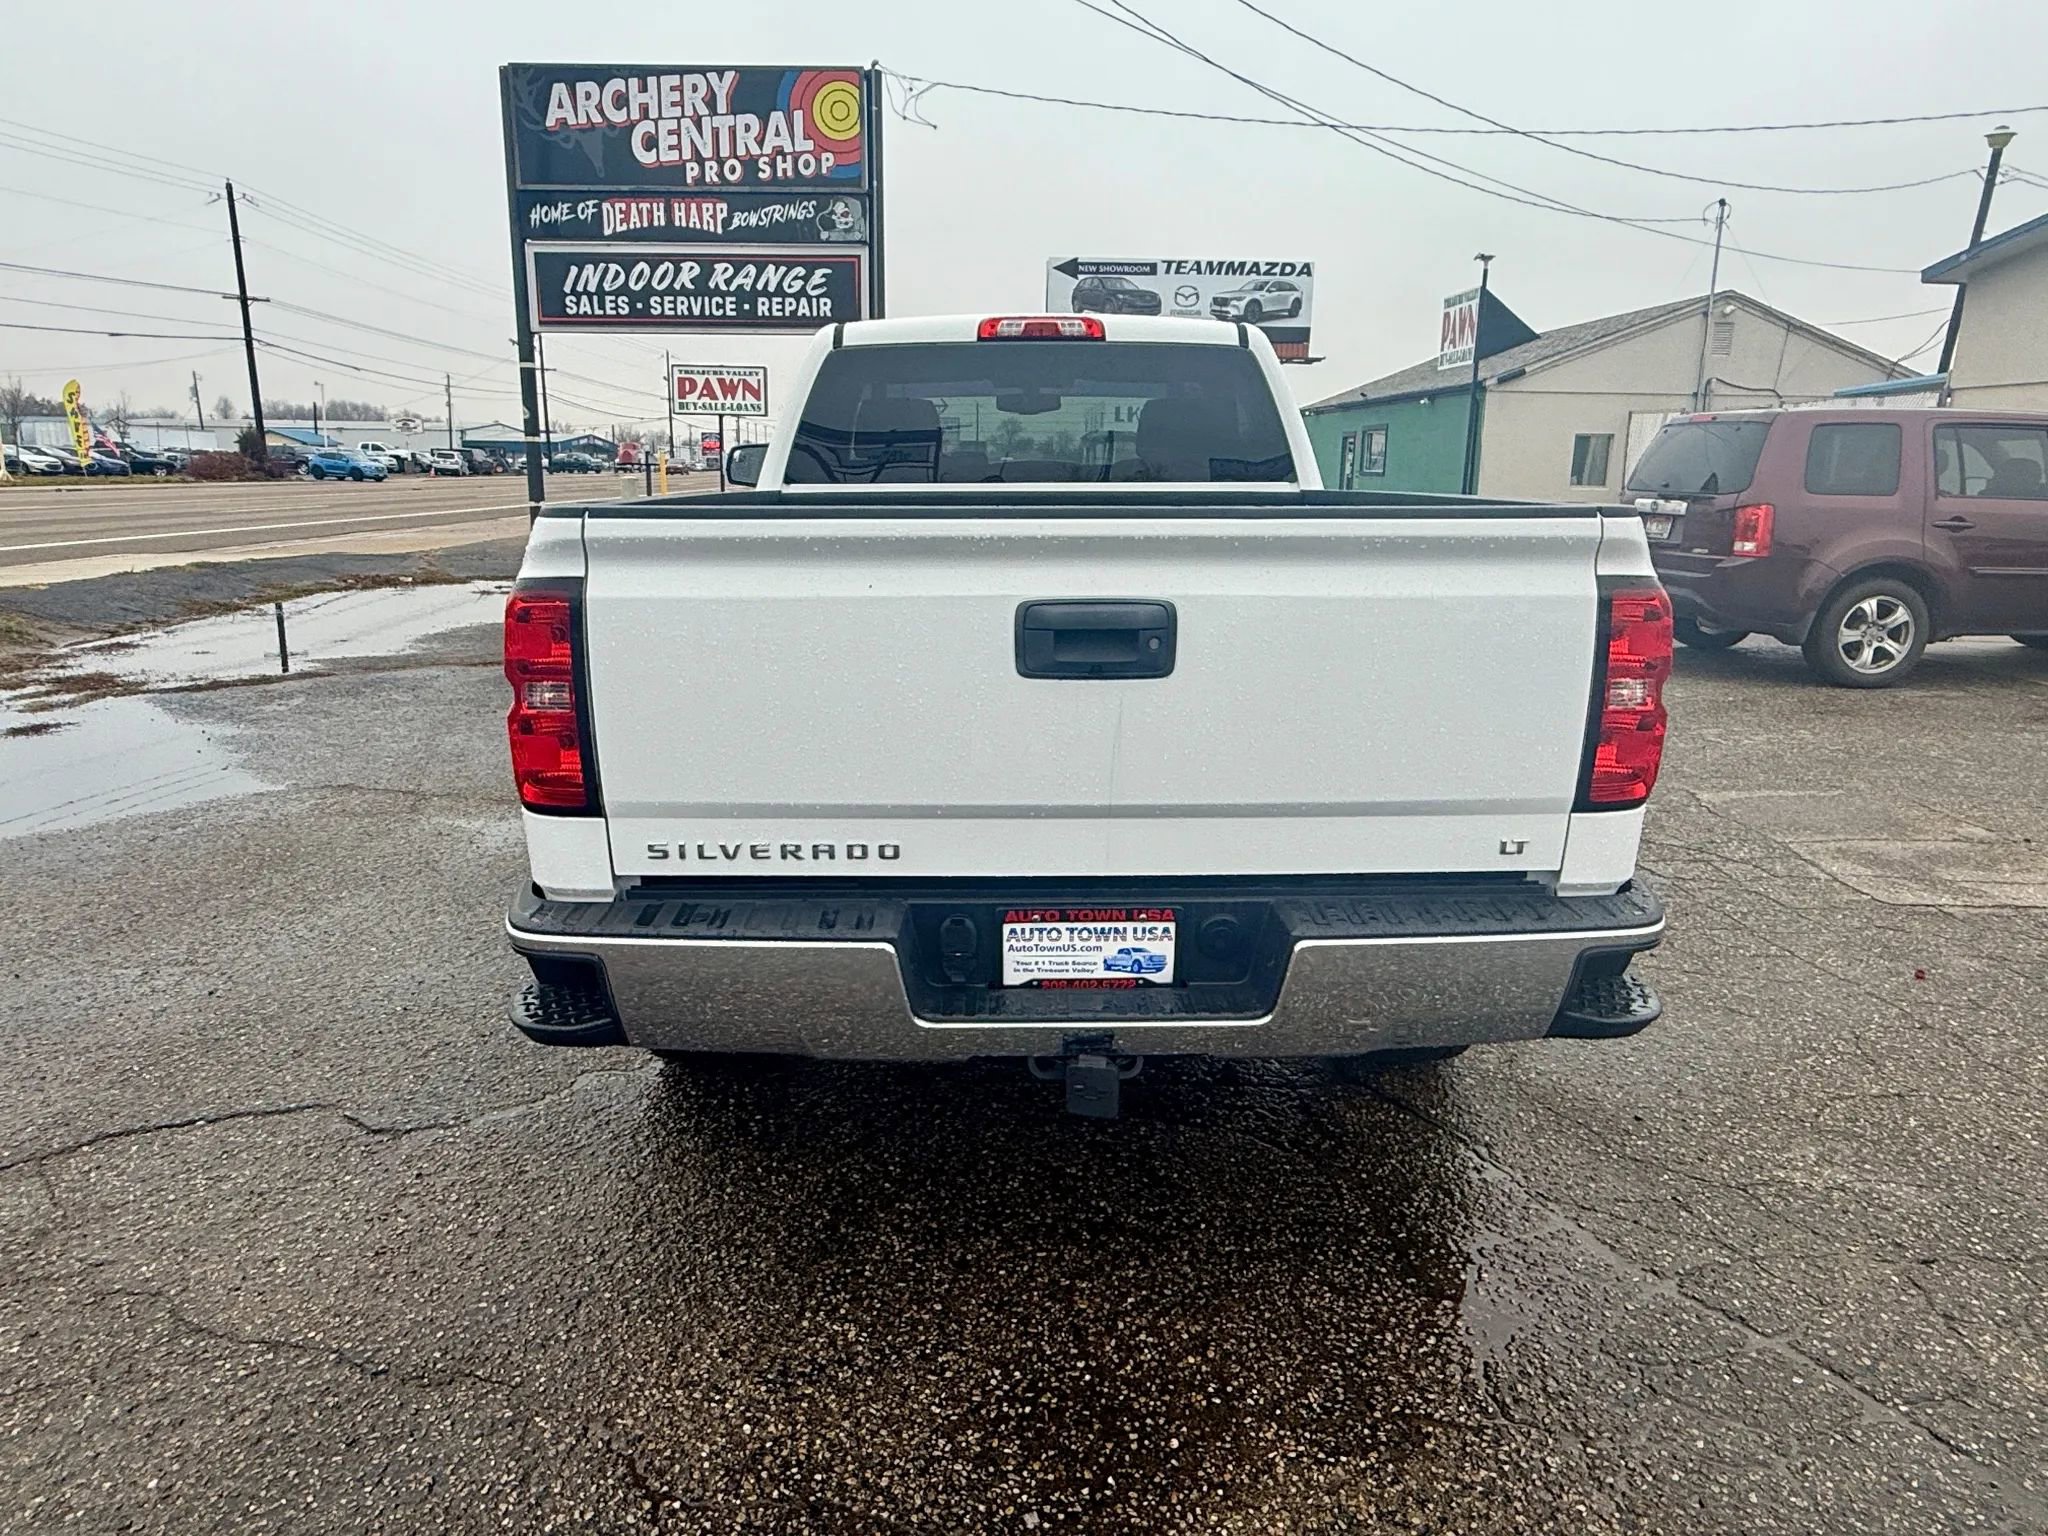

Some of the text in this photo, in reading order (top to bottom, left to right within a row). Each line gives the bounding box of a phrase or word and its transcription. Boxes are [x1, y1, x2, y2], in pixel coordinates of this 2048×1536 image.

[545, 70, 737, 129] ARCHERY
[631, 109, 815, 166] CENTRAL
[686, 152, 836, 184] PRO SHOP
[529, 199, 817, 236] HOME OF DEATH HARP BOWSTRINGS
[563, 261, 833, 296] INDOOR RANGE
[1078, 264, 1151, 273] NEW SHOWROOM
[1161, 260, 1313, 277] TEAMMAZDA
[564, 296, 832, 317] SALES SERVICE REPAIR
[1441, 303, 1476, 353] PAWN
[677, 377, 761, 401] PAWN
[647, 842, 900, 861] SILVERADO
[1499, 839, 1530, 855] LT
[1005, 909, 1175, 923] AUTO TOWN USA
[1006, 926, 1173, 942] AUTO TOWN USA
[1007, 943, 1103, 953] AutoTownUS.com
